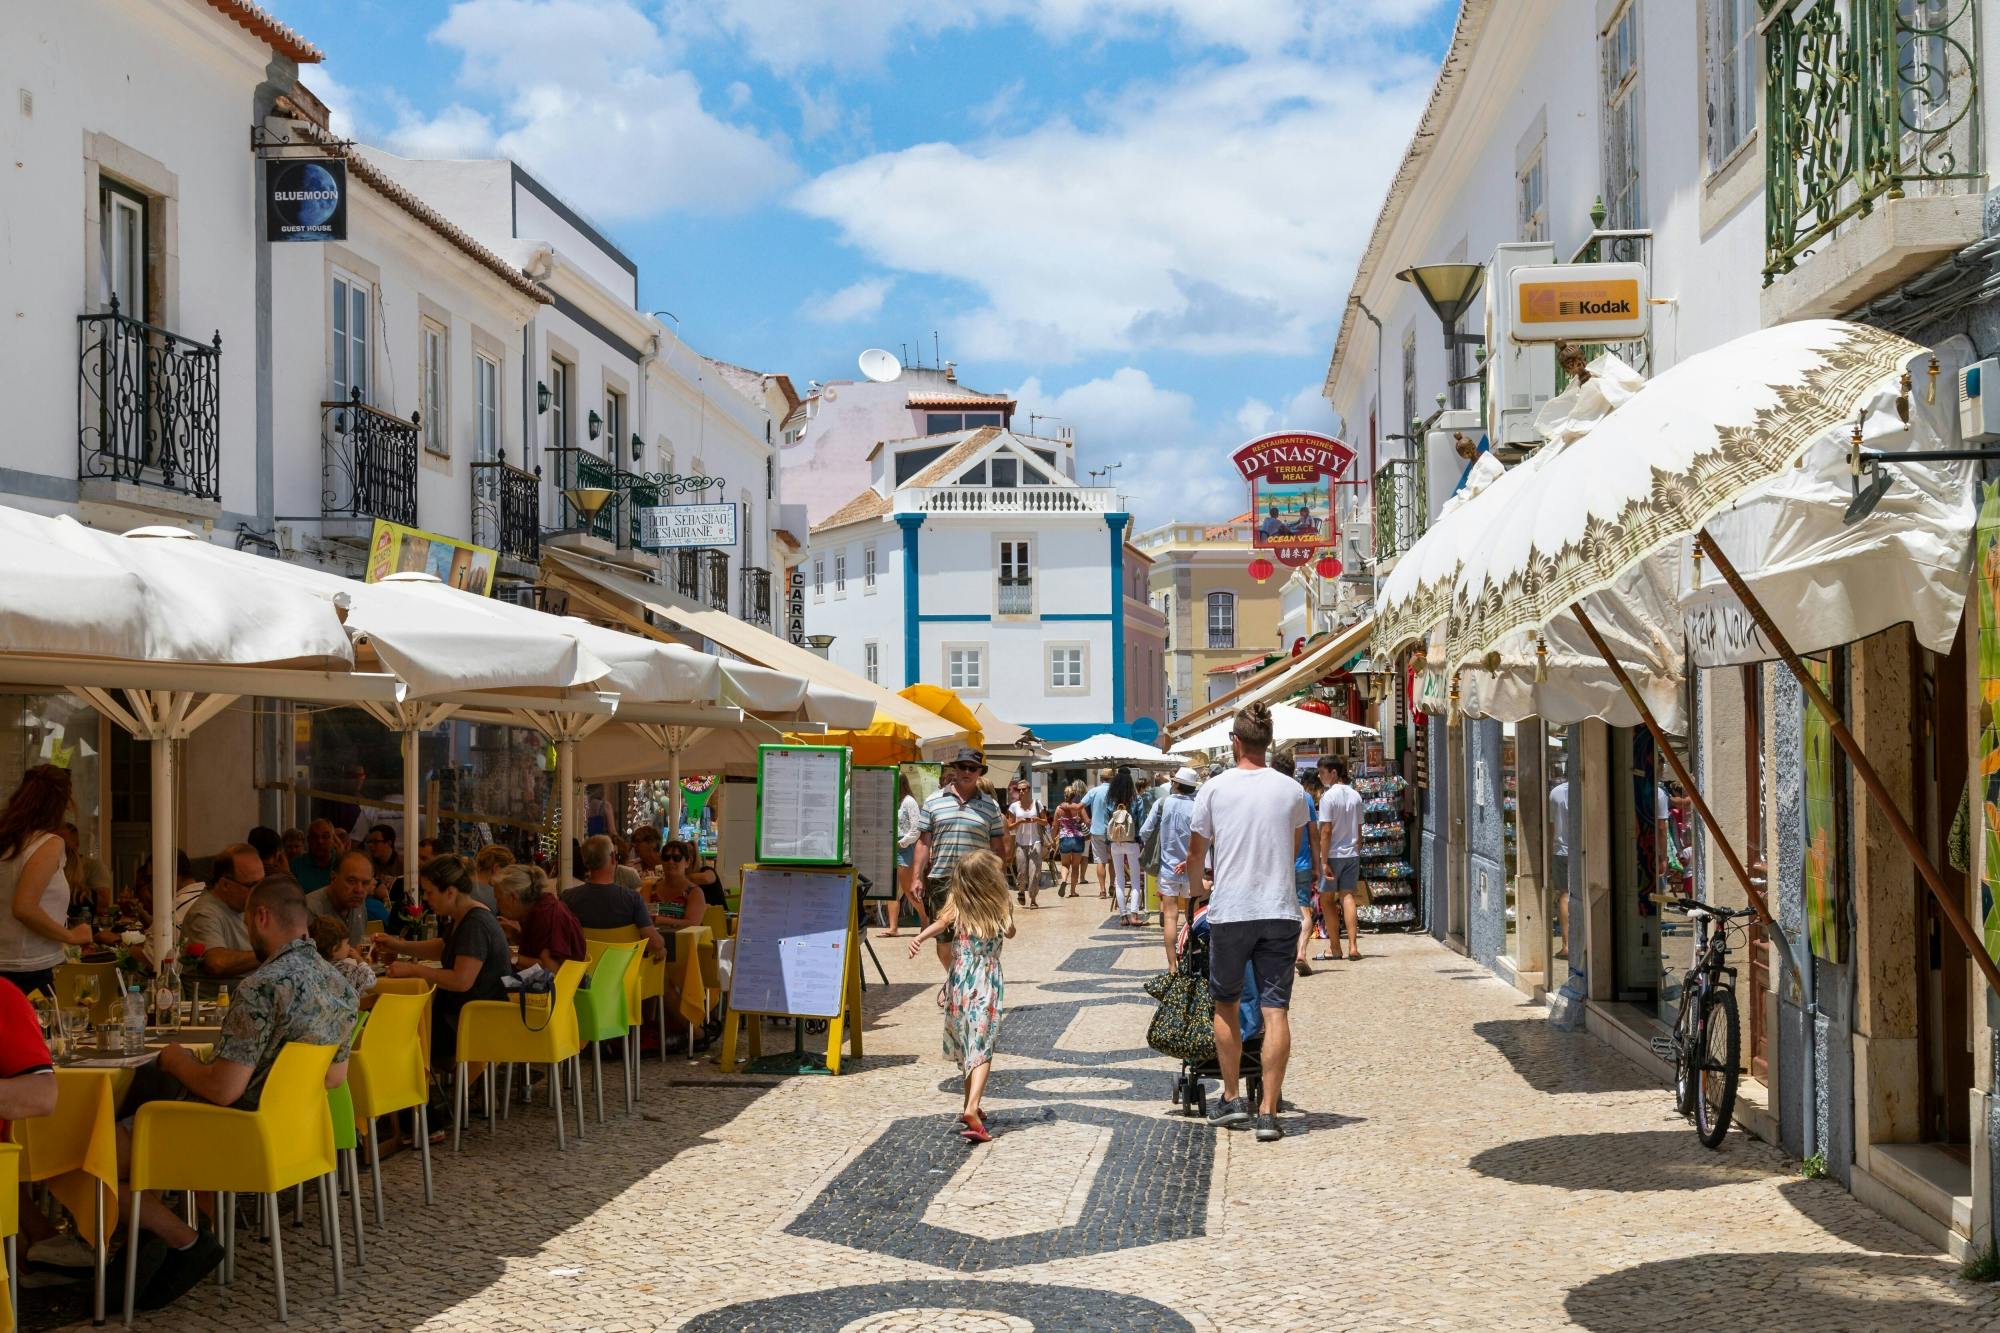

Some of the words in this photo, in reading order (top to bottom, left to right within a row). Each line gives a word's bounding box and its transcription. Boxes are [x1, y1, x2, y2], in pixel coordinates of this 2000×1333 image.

[274, 190, 339, 201] BLUEMOON
[307, 224, 332, 232] HOUSE
[1579, 300, 1631, 315] Kodak
[1252, 437, 1304, 454] RESTAURANTE
[1305, 438, 1335, 451] CHINÊS
[1241, 445, 1347, 475] DYNASTY
[1274, 465, 1314, 473] TERRACE
[1282, 473, 1306, 481] MEAL
[648, 515, 668, 527] DON
[649, 525, 713, 539] RESTAURANTE
[1267, 535, 1295, 543] OCEAN
[1297, 533, 1322, 541] VIEW
